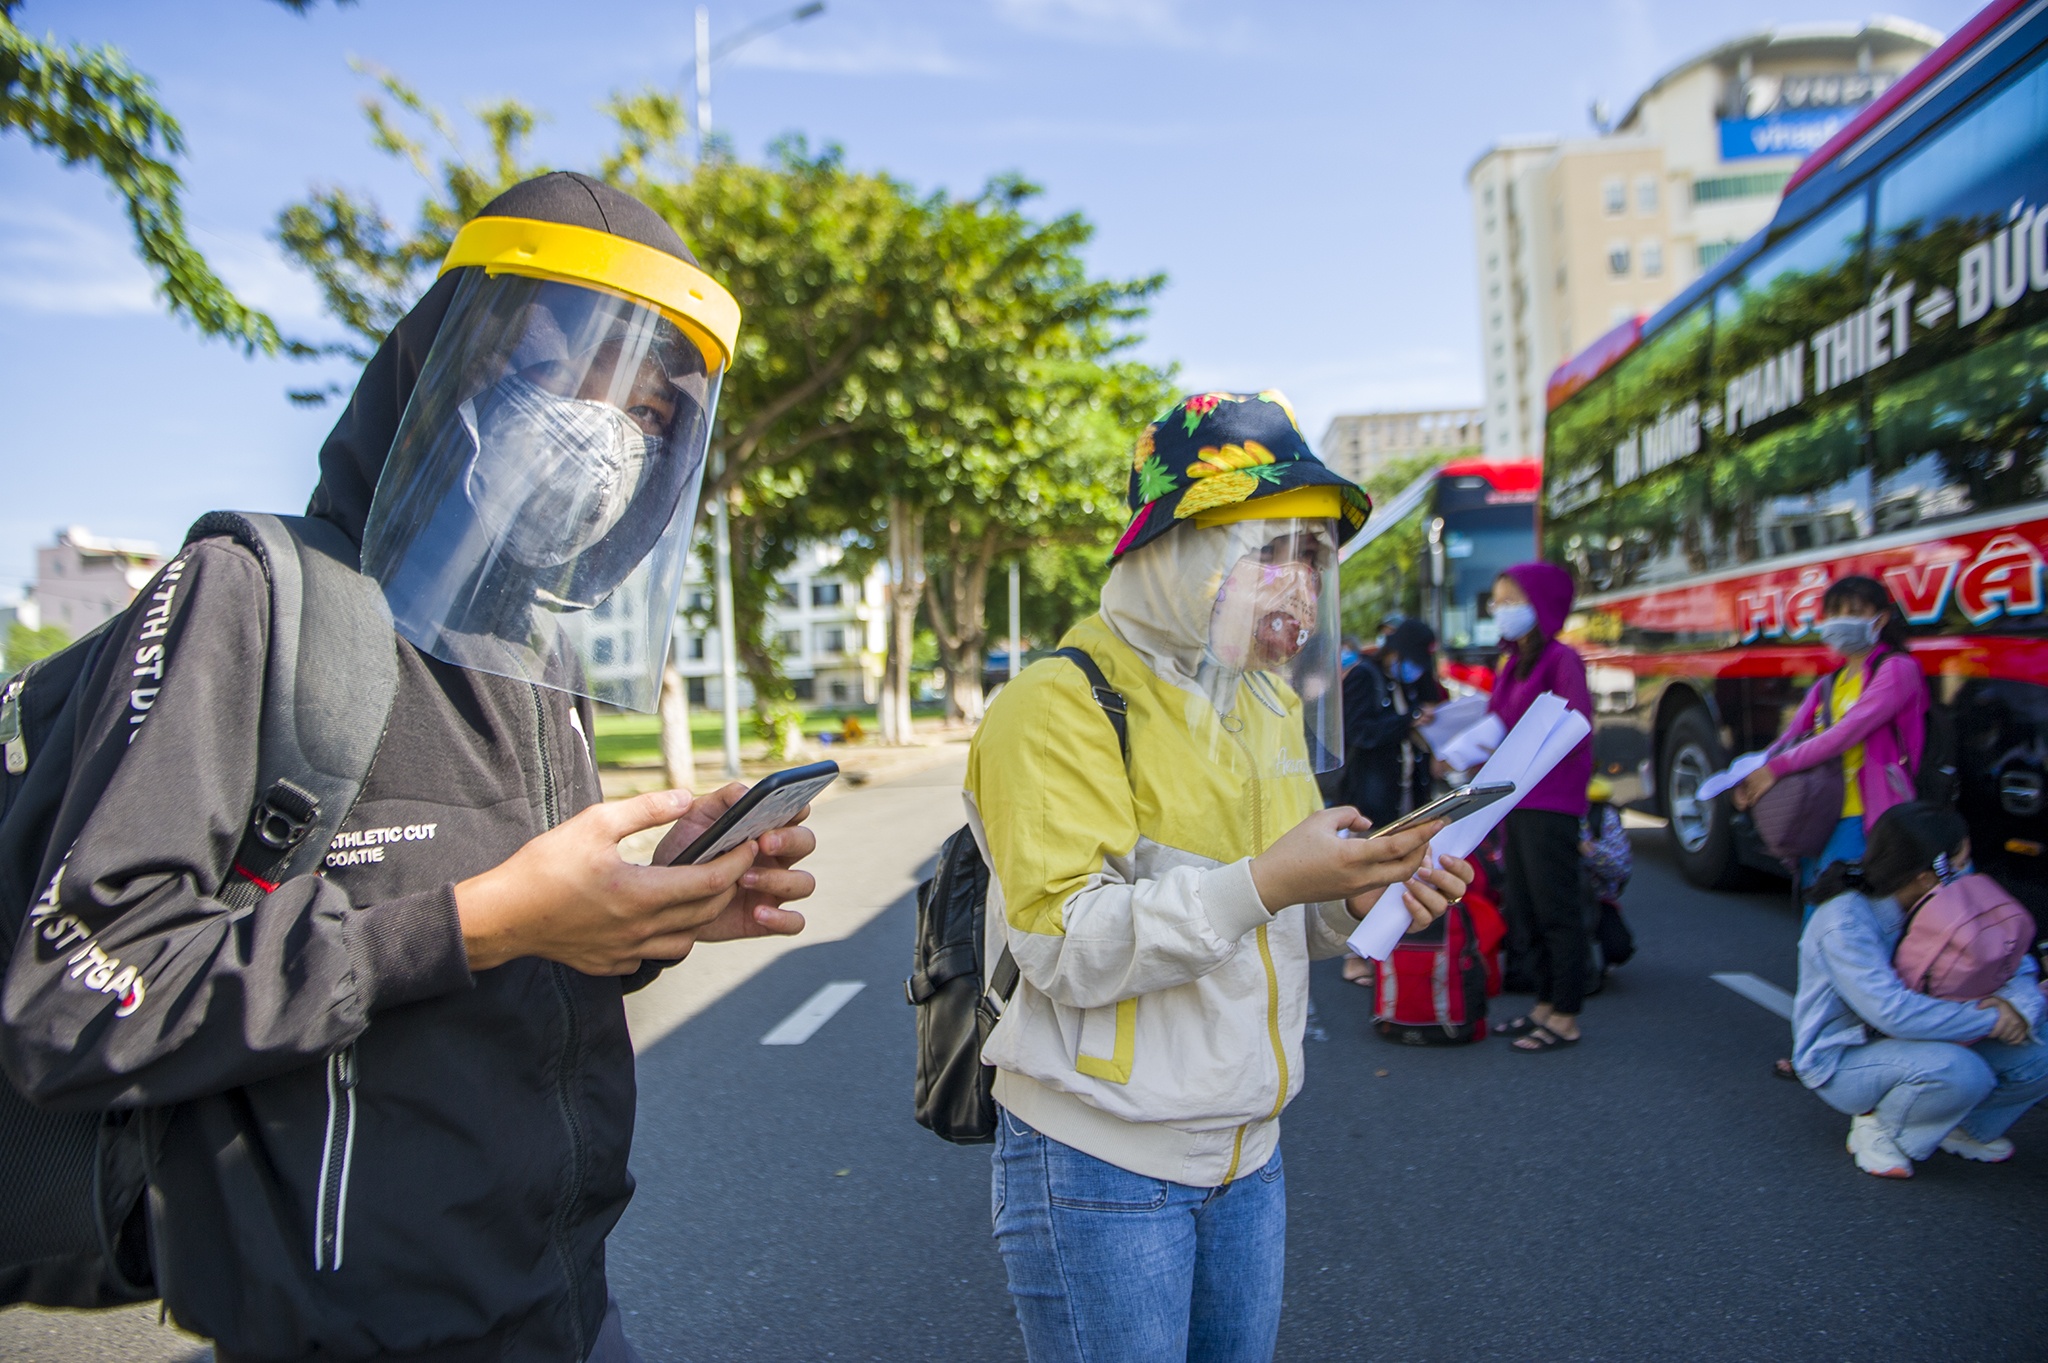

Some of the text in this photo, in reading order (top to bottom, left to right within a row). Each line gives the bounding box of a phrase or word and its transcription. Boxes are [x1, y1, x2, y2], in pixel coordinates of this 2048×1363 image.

[1810, 269, 1917, 396] THIẾT
[1736, 565, 1829, 645] HẢ
[326, 846, 385, 868] COATIE
[404, 823, 438, 841] CUT
